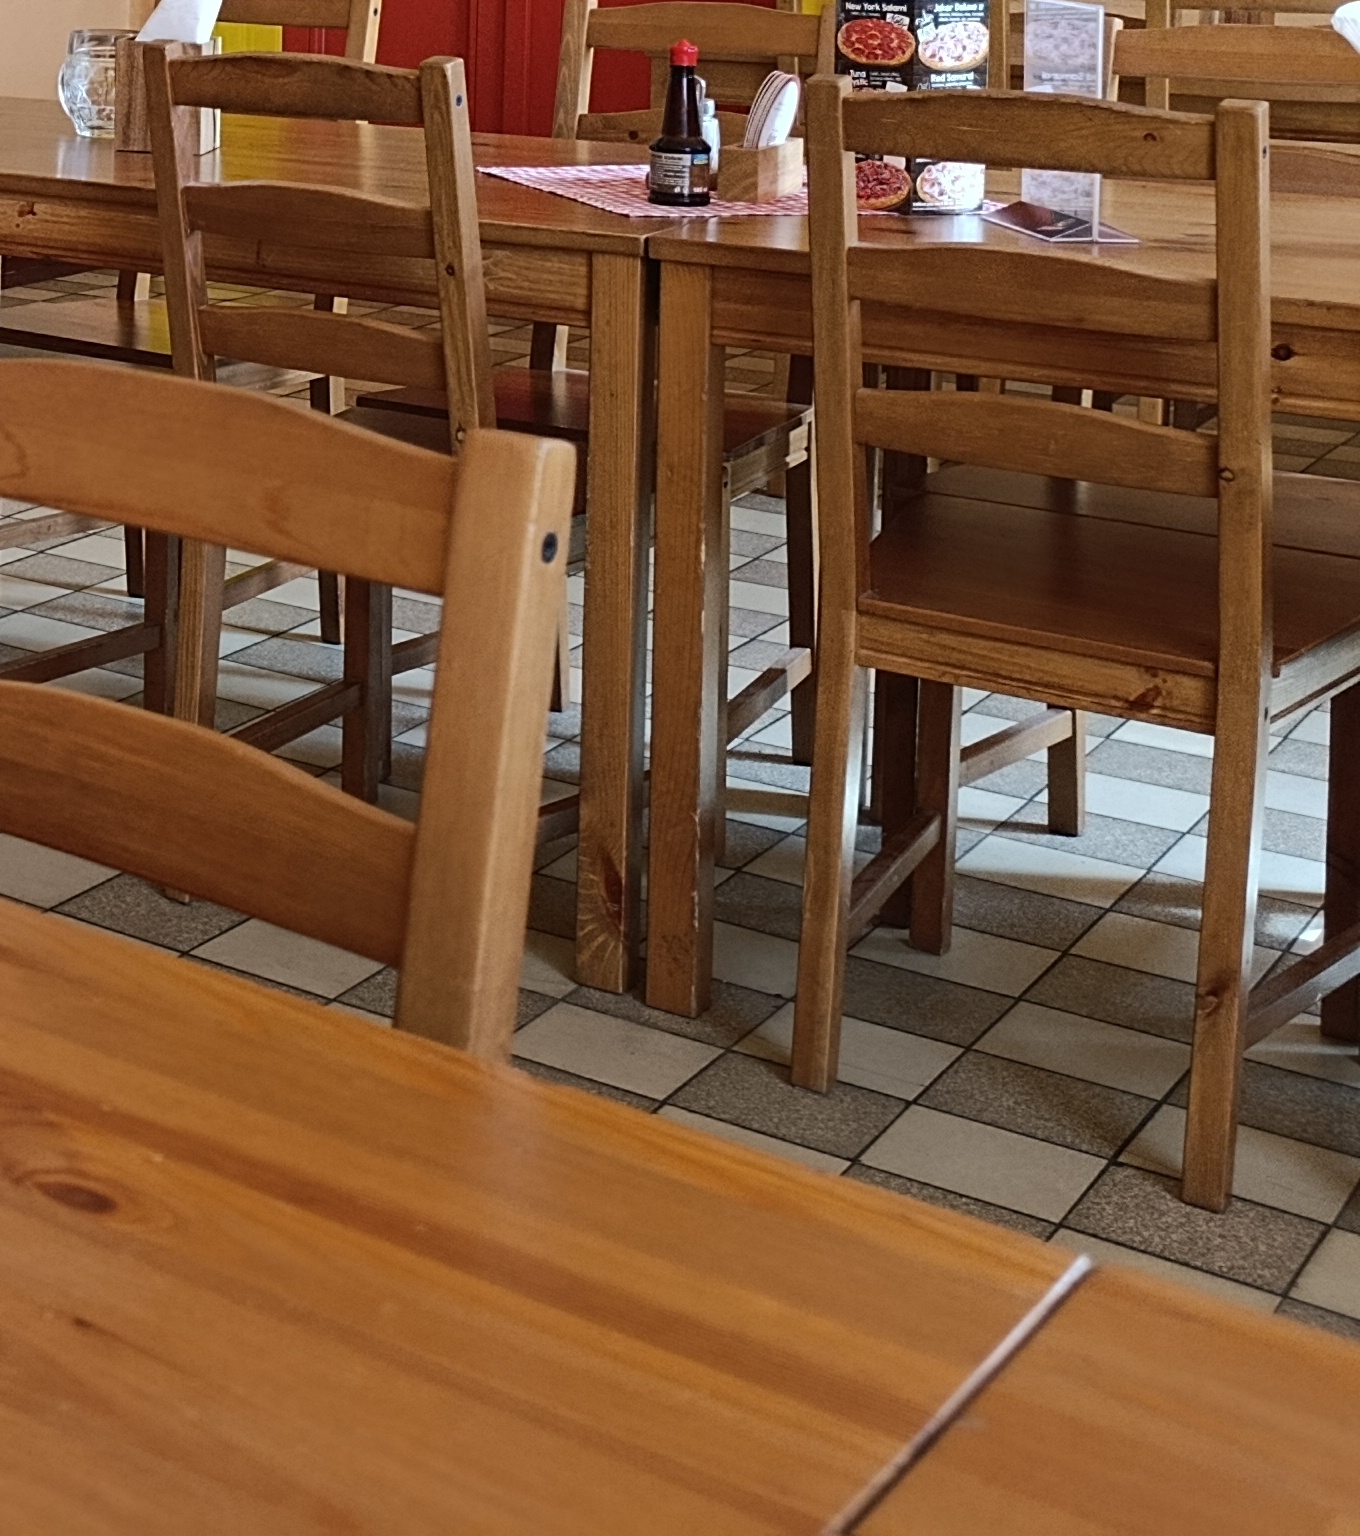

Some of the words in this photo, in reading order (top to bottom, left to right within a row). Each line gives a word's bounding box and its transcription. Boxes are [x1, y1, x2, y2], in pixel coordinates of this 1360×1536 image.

[845, 2, 862, 12] New
[864, 2, 881, 11] York
[882, 3, 907, 12] Salami
[850, 69, 867, 78] Tuna
[852, 77, 869, 86] ystic
